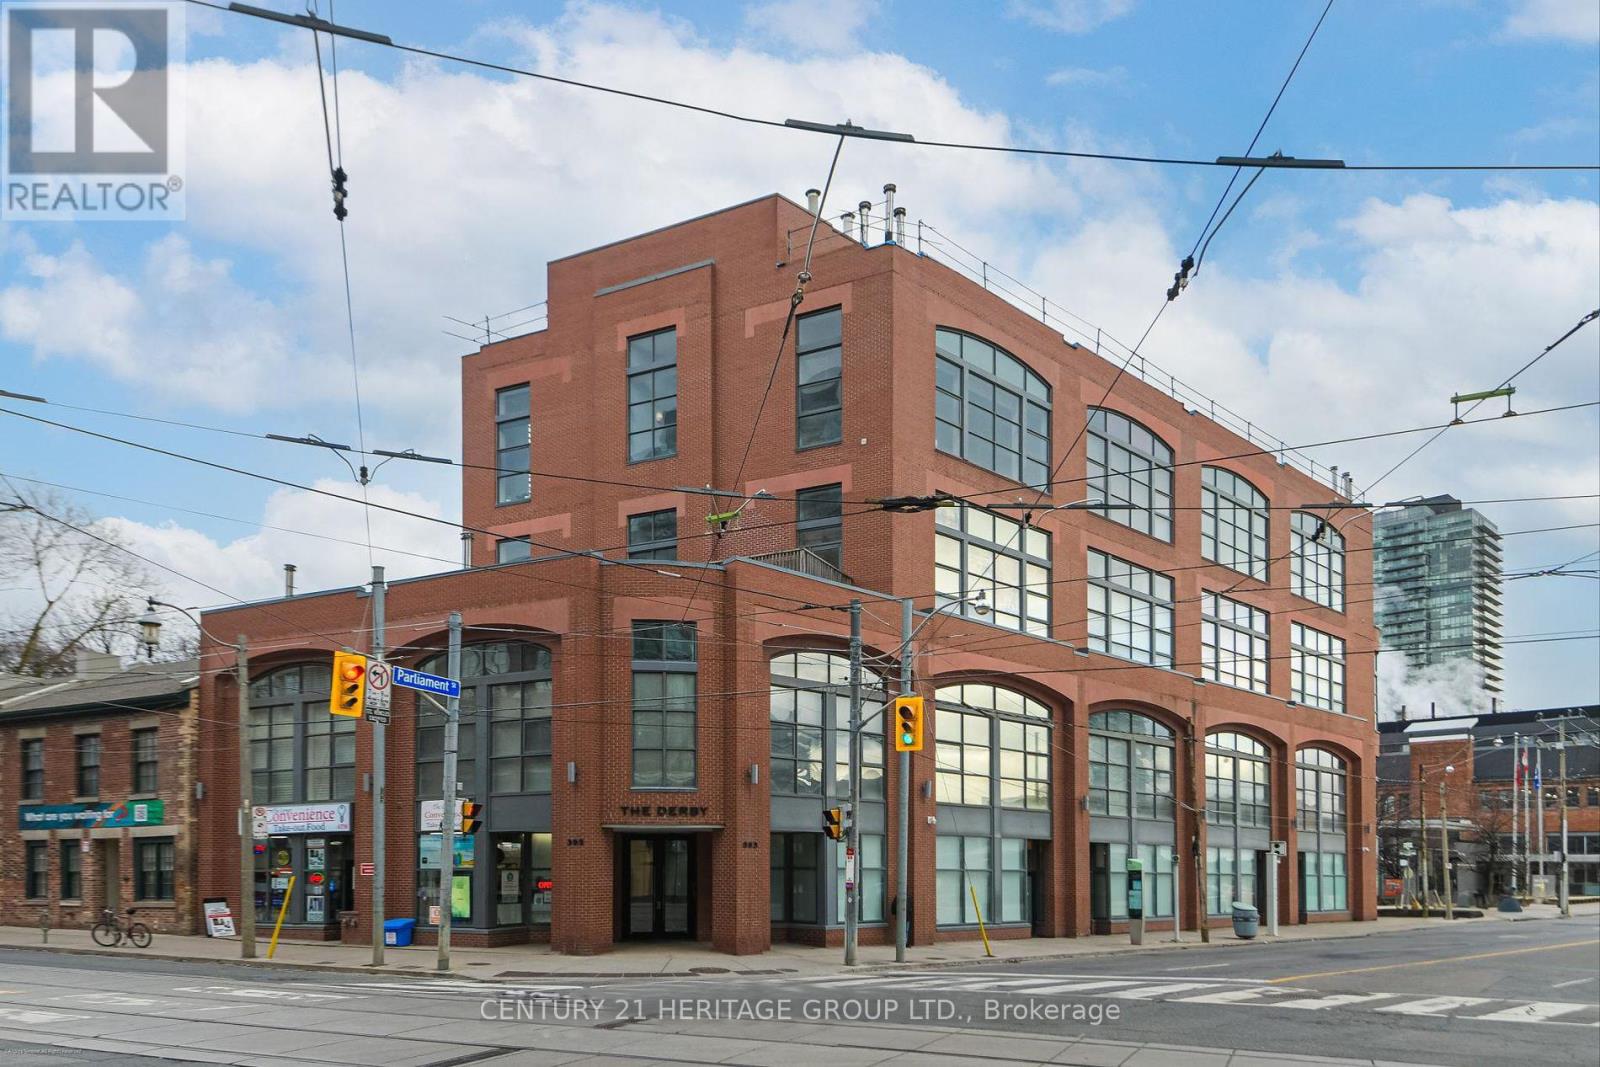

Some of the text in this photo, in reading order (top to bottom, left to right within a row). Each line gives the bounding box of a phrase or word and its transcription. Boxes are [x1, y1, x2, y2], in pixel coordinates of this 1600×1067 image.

[397, 670, 449, 692] Parliament
[621, 806, 708, 817] THE DERBY
[307, 823, 326, 831] Food
